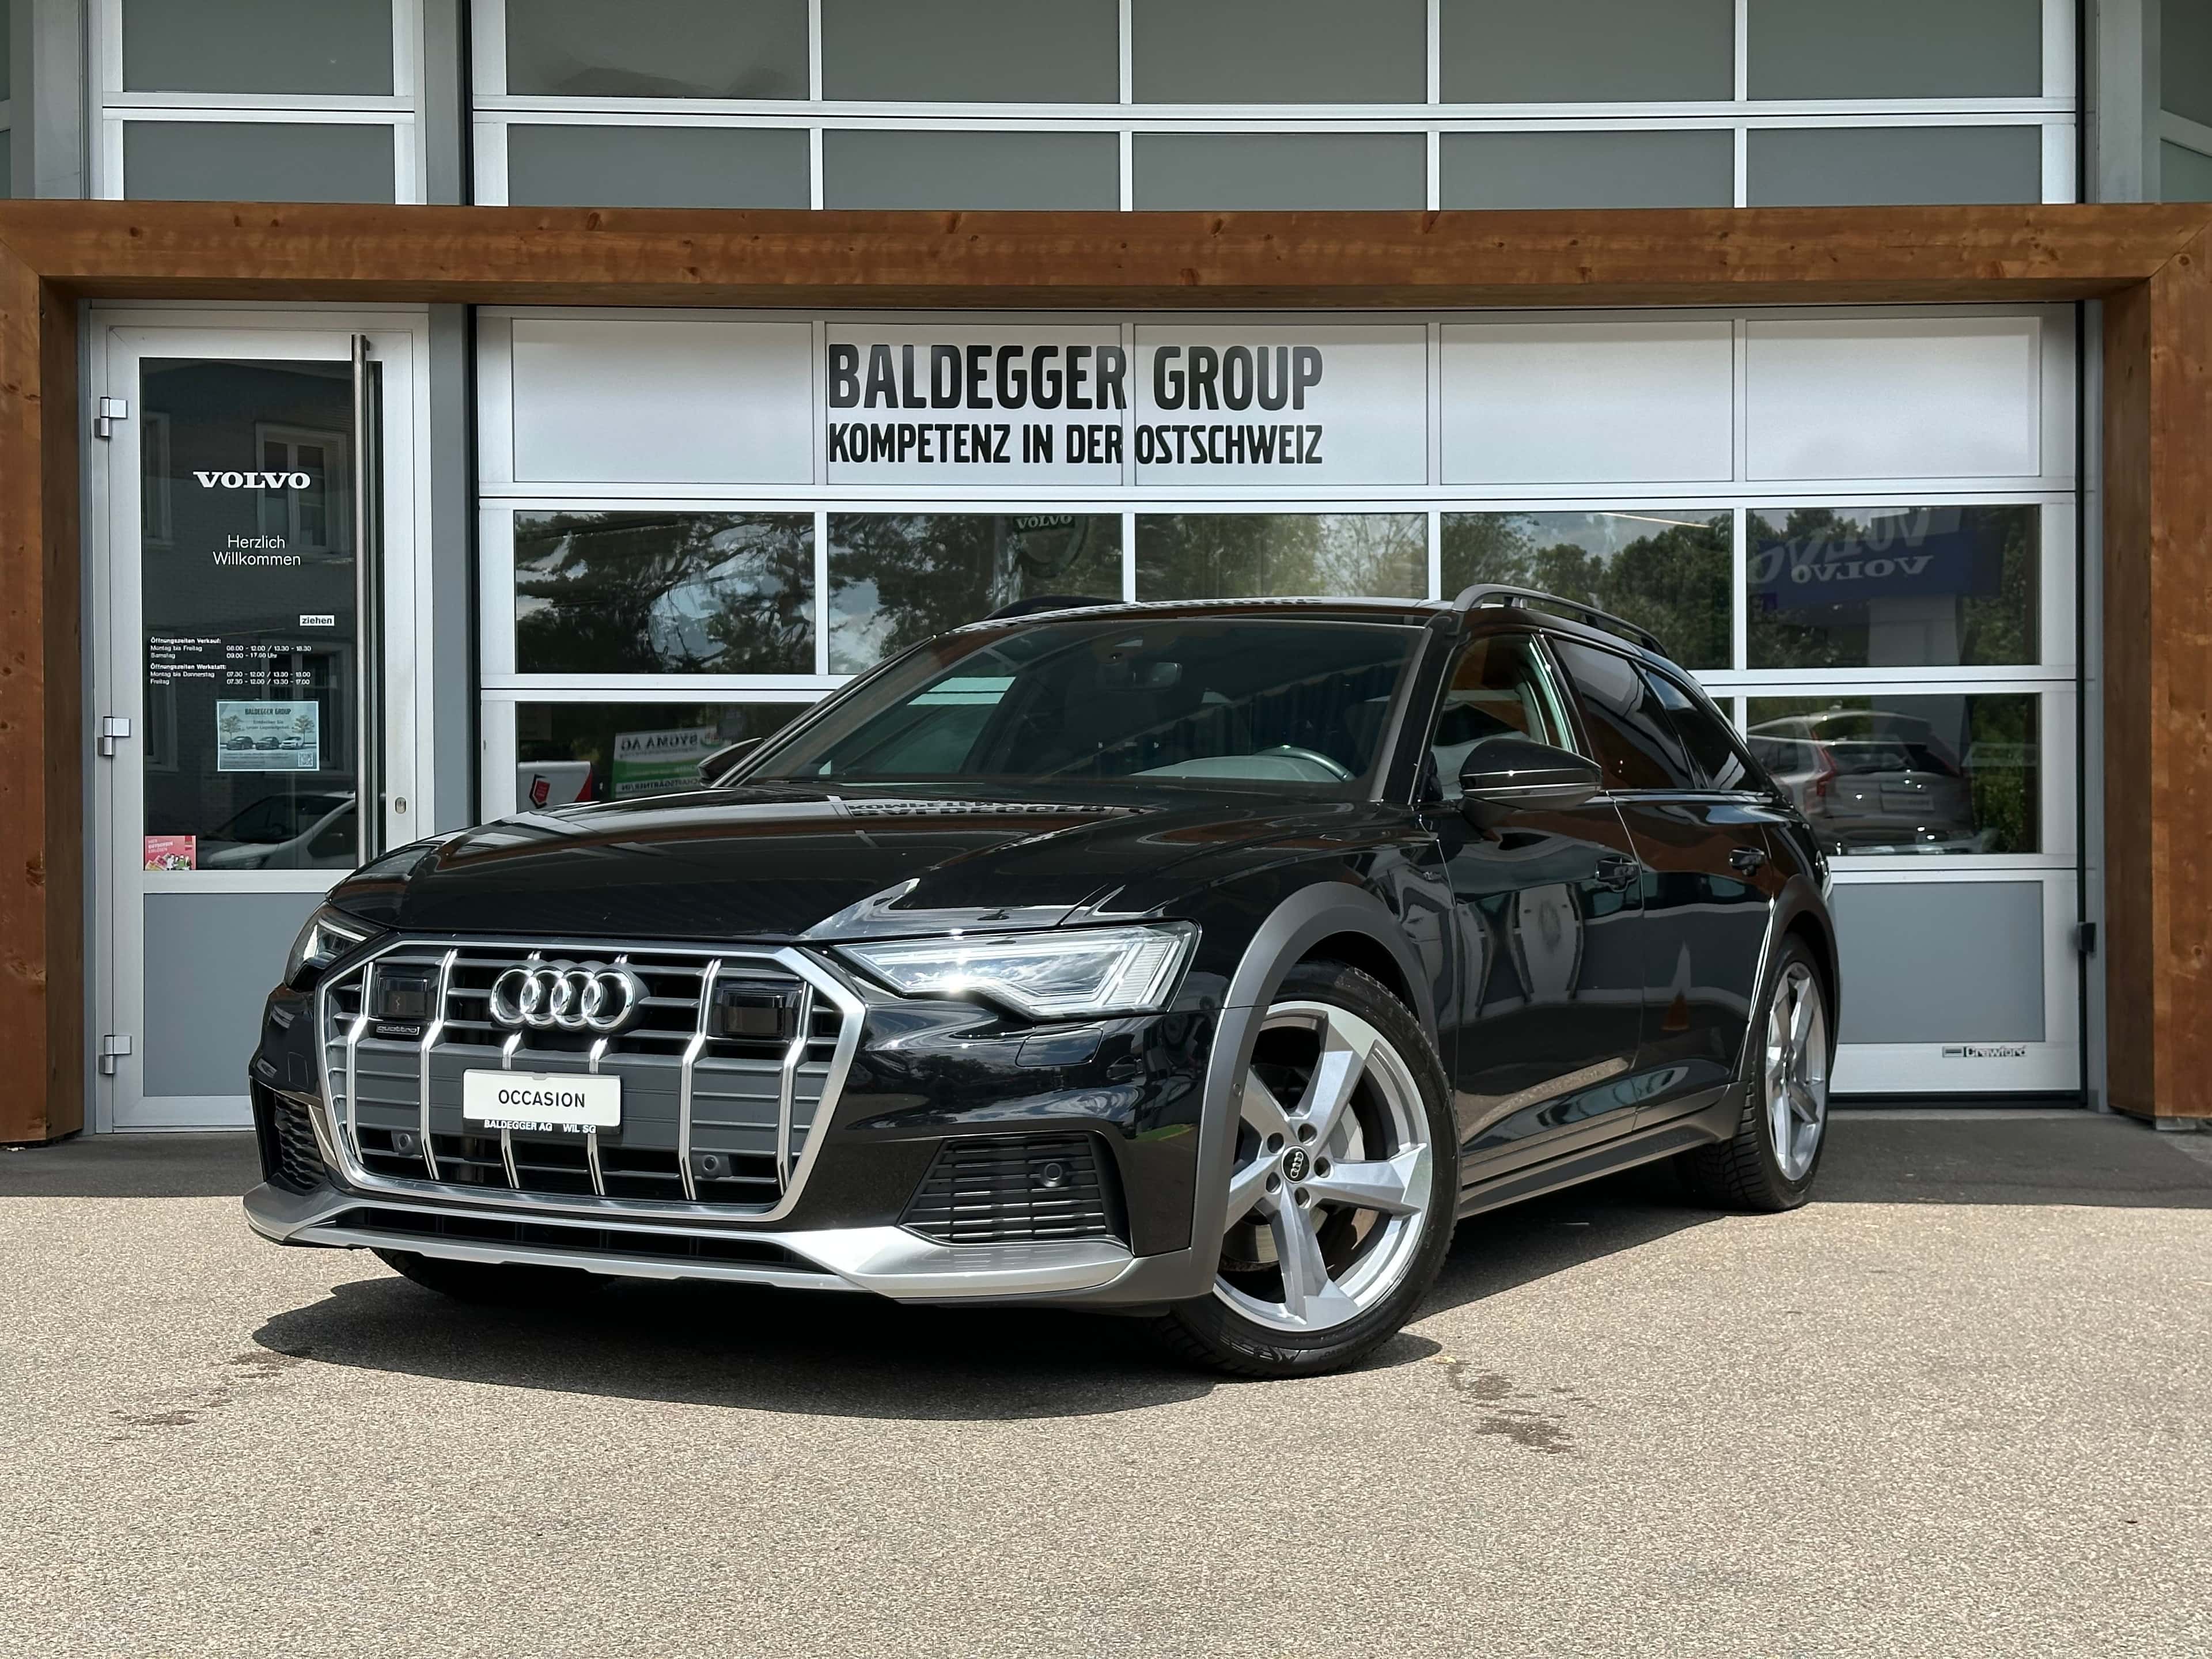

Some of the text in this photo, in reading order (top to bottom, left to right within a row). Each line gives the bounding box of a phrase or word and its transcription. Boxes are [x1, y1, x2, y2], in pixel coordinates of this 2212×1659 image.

[828, 344, 1323, 411] BALDEGGER GROUP
[829, 423, 1323, 464] KOMPETENZ IN DER OSTSCHWEIZ
[193, 471, 311, 489] VOLVO
[228, 535, 286, 549] Herzlich
[213, 551, 301, 566] Willkommen
[1967, 1045, 2027, 1058] Crawford
[498, 1089, 585, 1108] OCCASION
[484, 1119, 597, 1134] BALDEGGER AG WIL SG
